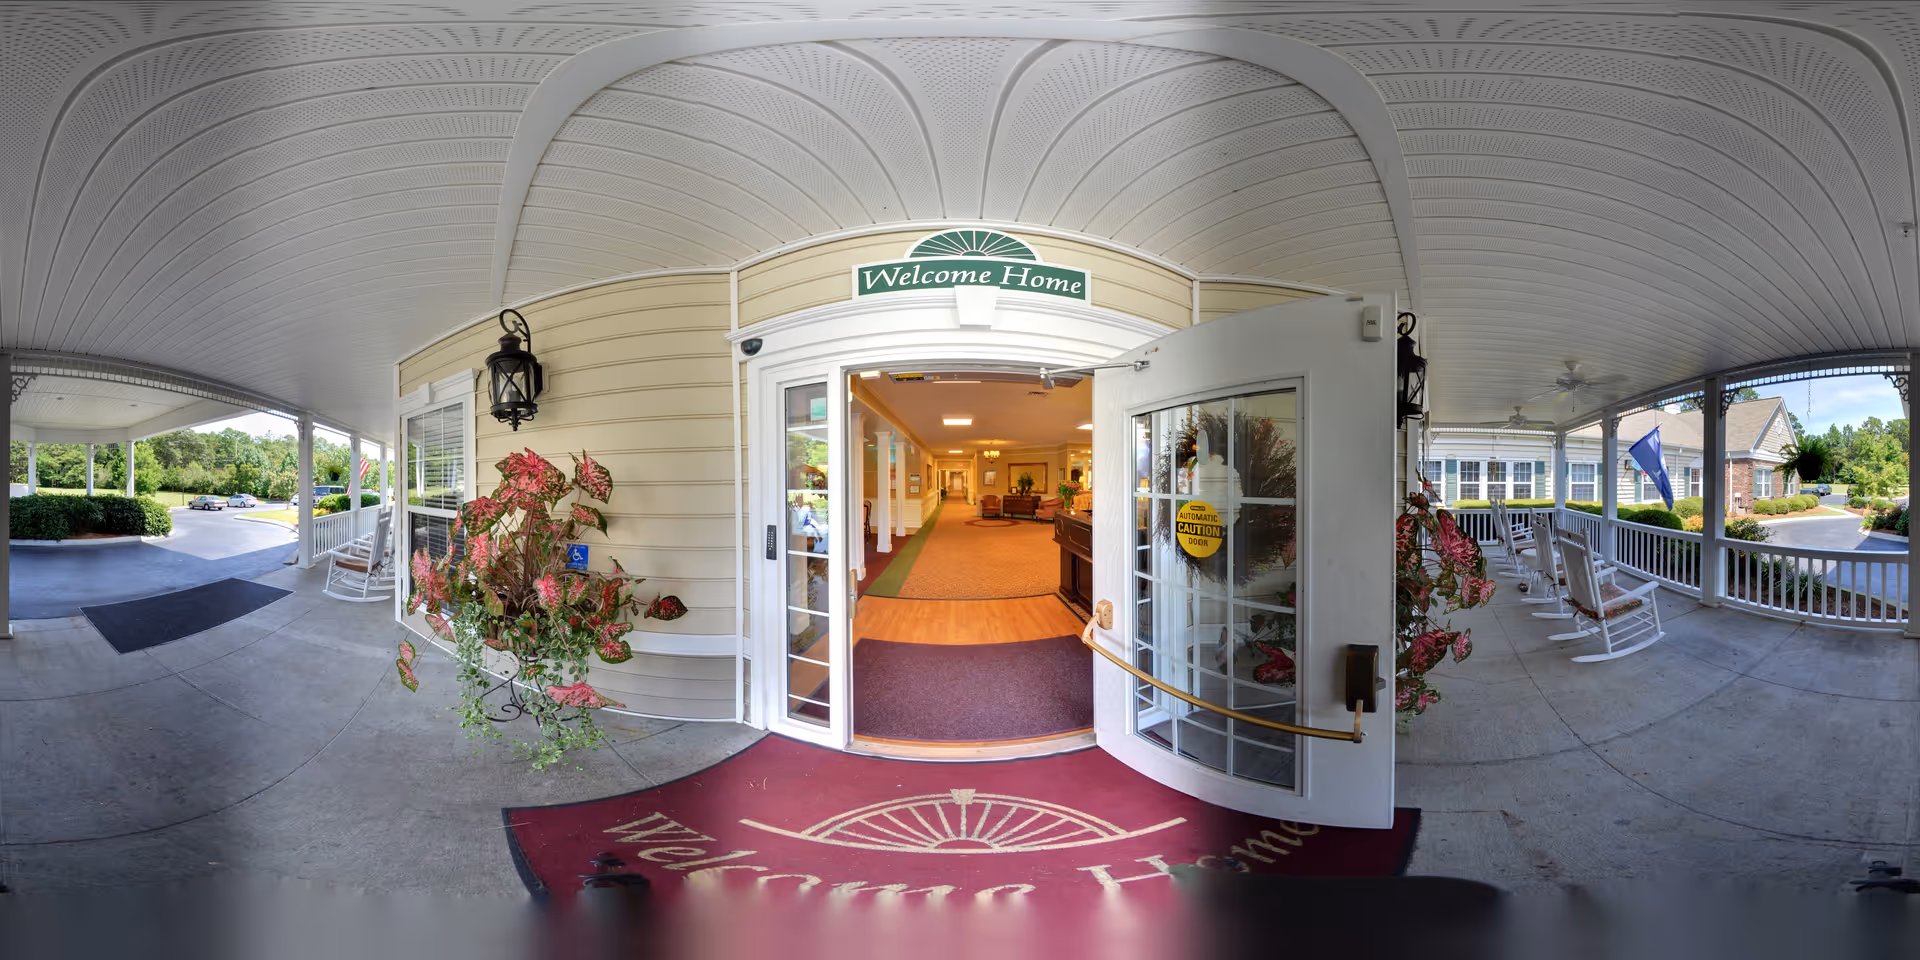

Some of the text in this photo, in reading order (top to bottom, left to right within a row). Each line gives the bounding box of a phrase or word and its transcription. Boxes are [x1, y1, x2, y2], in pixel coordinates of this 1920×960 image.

[862, 265, 1082, 294] Welcome Home
[1179, 512, 1218, 522] AUTOMATIC
[1178, 523, 1220, 537] CAUTION
[1188, 537, 1208, 546] DOOR
